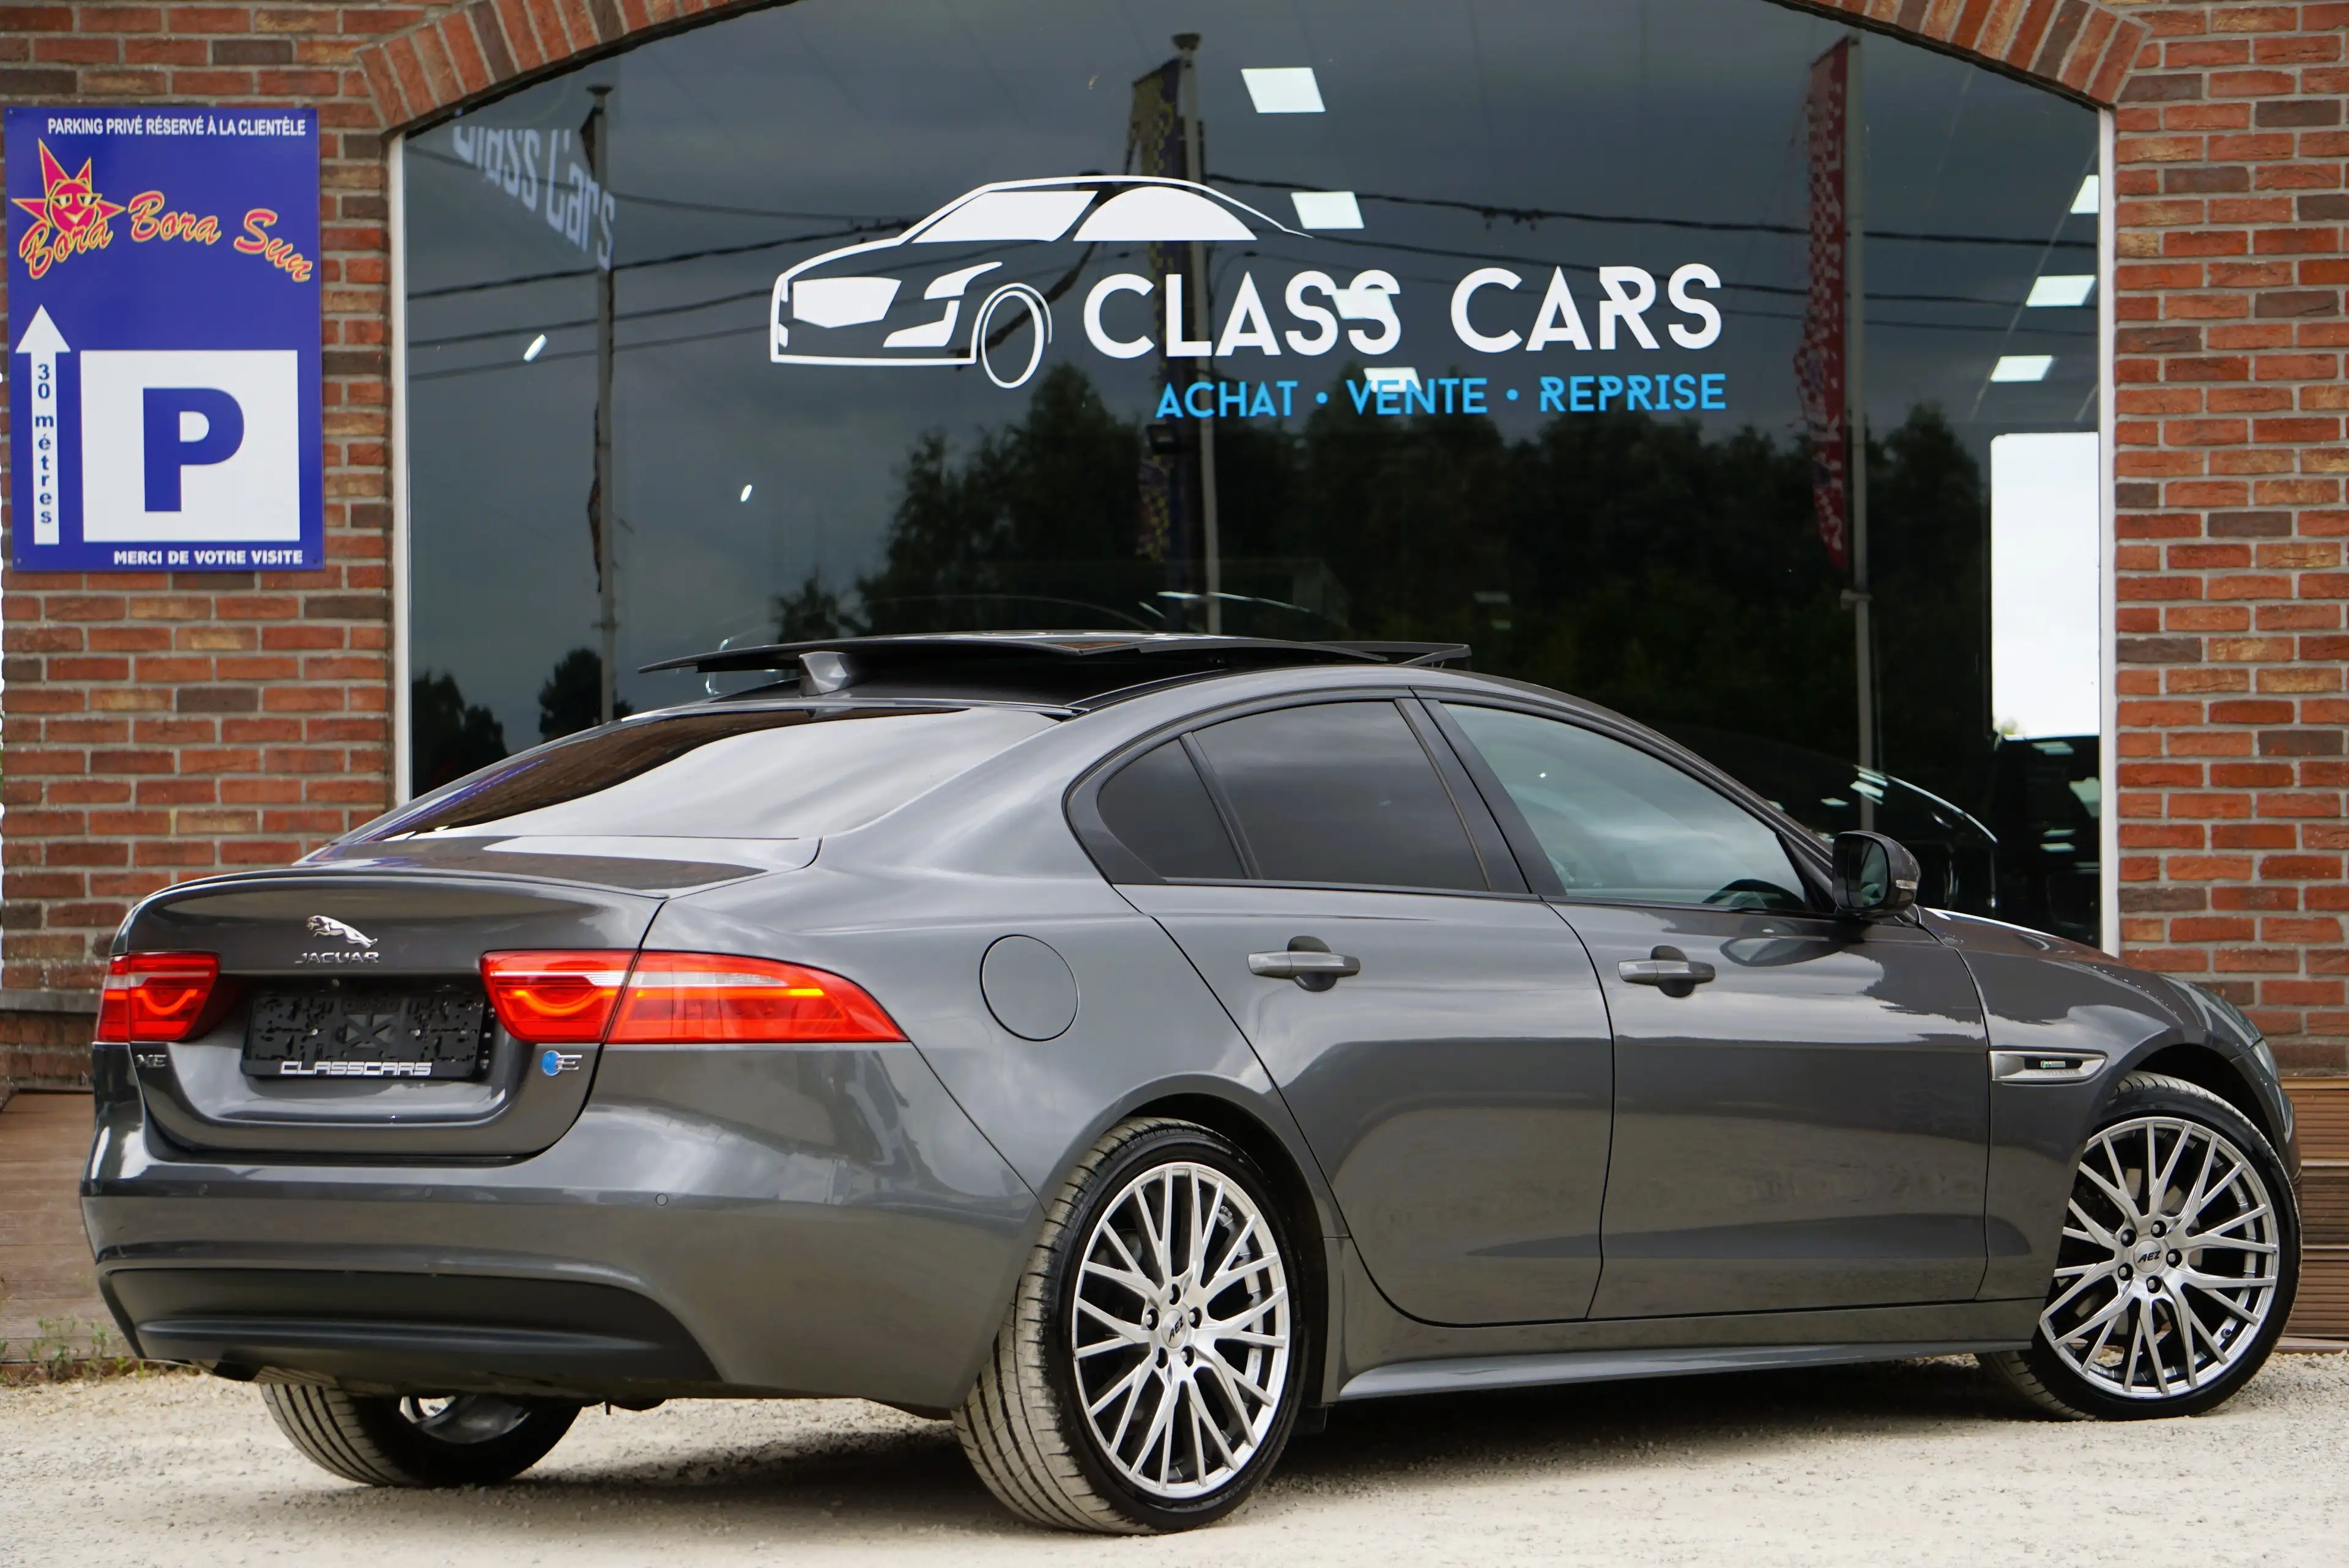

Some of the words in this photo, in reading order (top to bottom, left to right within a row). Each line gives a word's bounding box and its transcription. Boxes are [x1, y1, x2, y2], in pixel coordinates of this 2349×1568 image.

[48, 117, 103, 135] PARKING
[106, 115, 143, 135] PRIVÉ
[146, 115, 204, 136] RÉSERVÉ
[207, 115, 217, 136] À
[219, 119, 237, 136] LA
[20, 216, 113, 279] Bora
[128, 191, 221, 245] Bora
[234, 209, 313, 282] Sun
[1083, 269, 1401, 360] CLASS
[1450, 263, 1722, 353] CARS
[37, 364, 50, 399] 30
[1156, 380, 1299, 418] ACHAT
[1346, 377, 1488, 415] VENTE
[1540, 373, 1726, 412] REPRISE
[143, 387, 245, 512] P
[114, 550, 162, 565] MERCI
[167, 550, 189, 564] DE
[193, 550, 246, 564] VOTRE
[251, 550, 303, 564] VISITE
[294, 952, 379, 964] JAGUAR
[280, 1060, 432, 1076] CLASSCARS
[2137, 1250, 2161, 1263] AEZ
[1168, 1315, 1184, 1343] AEZ
